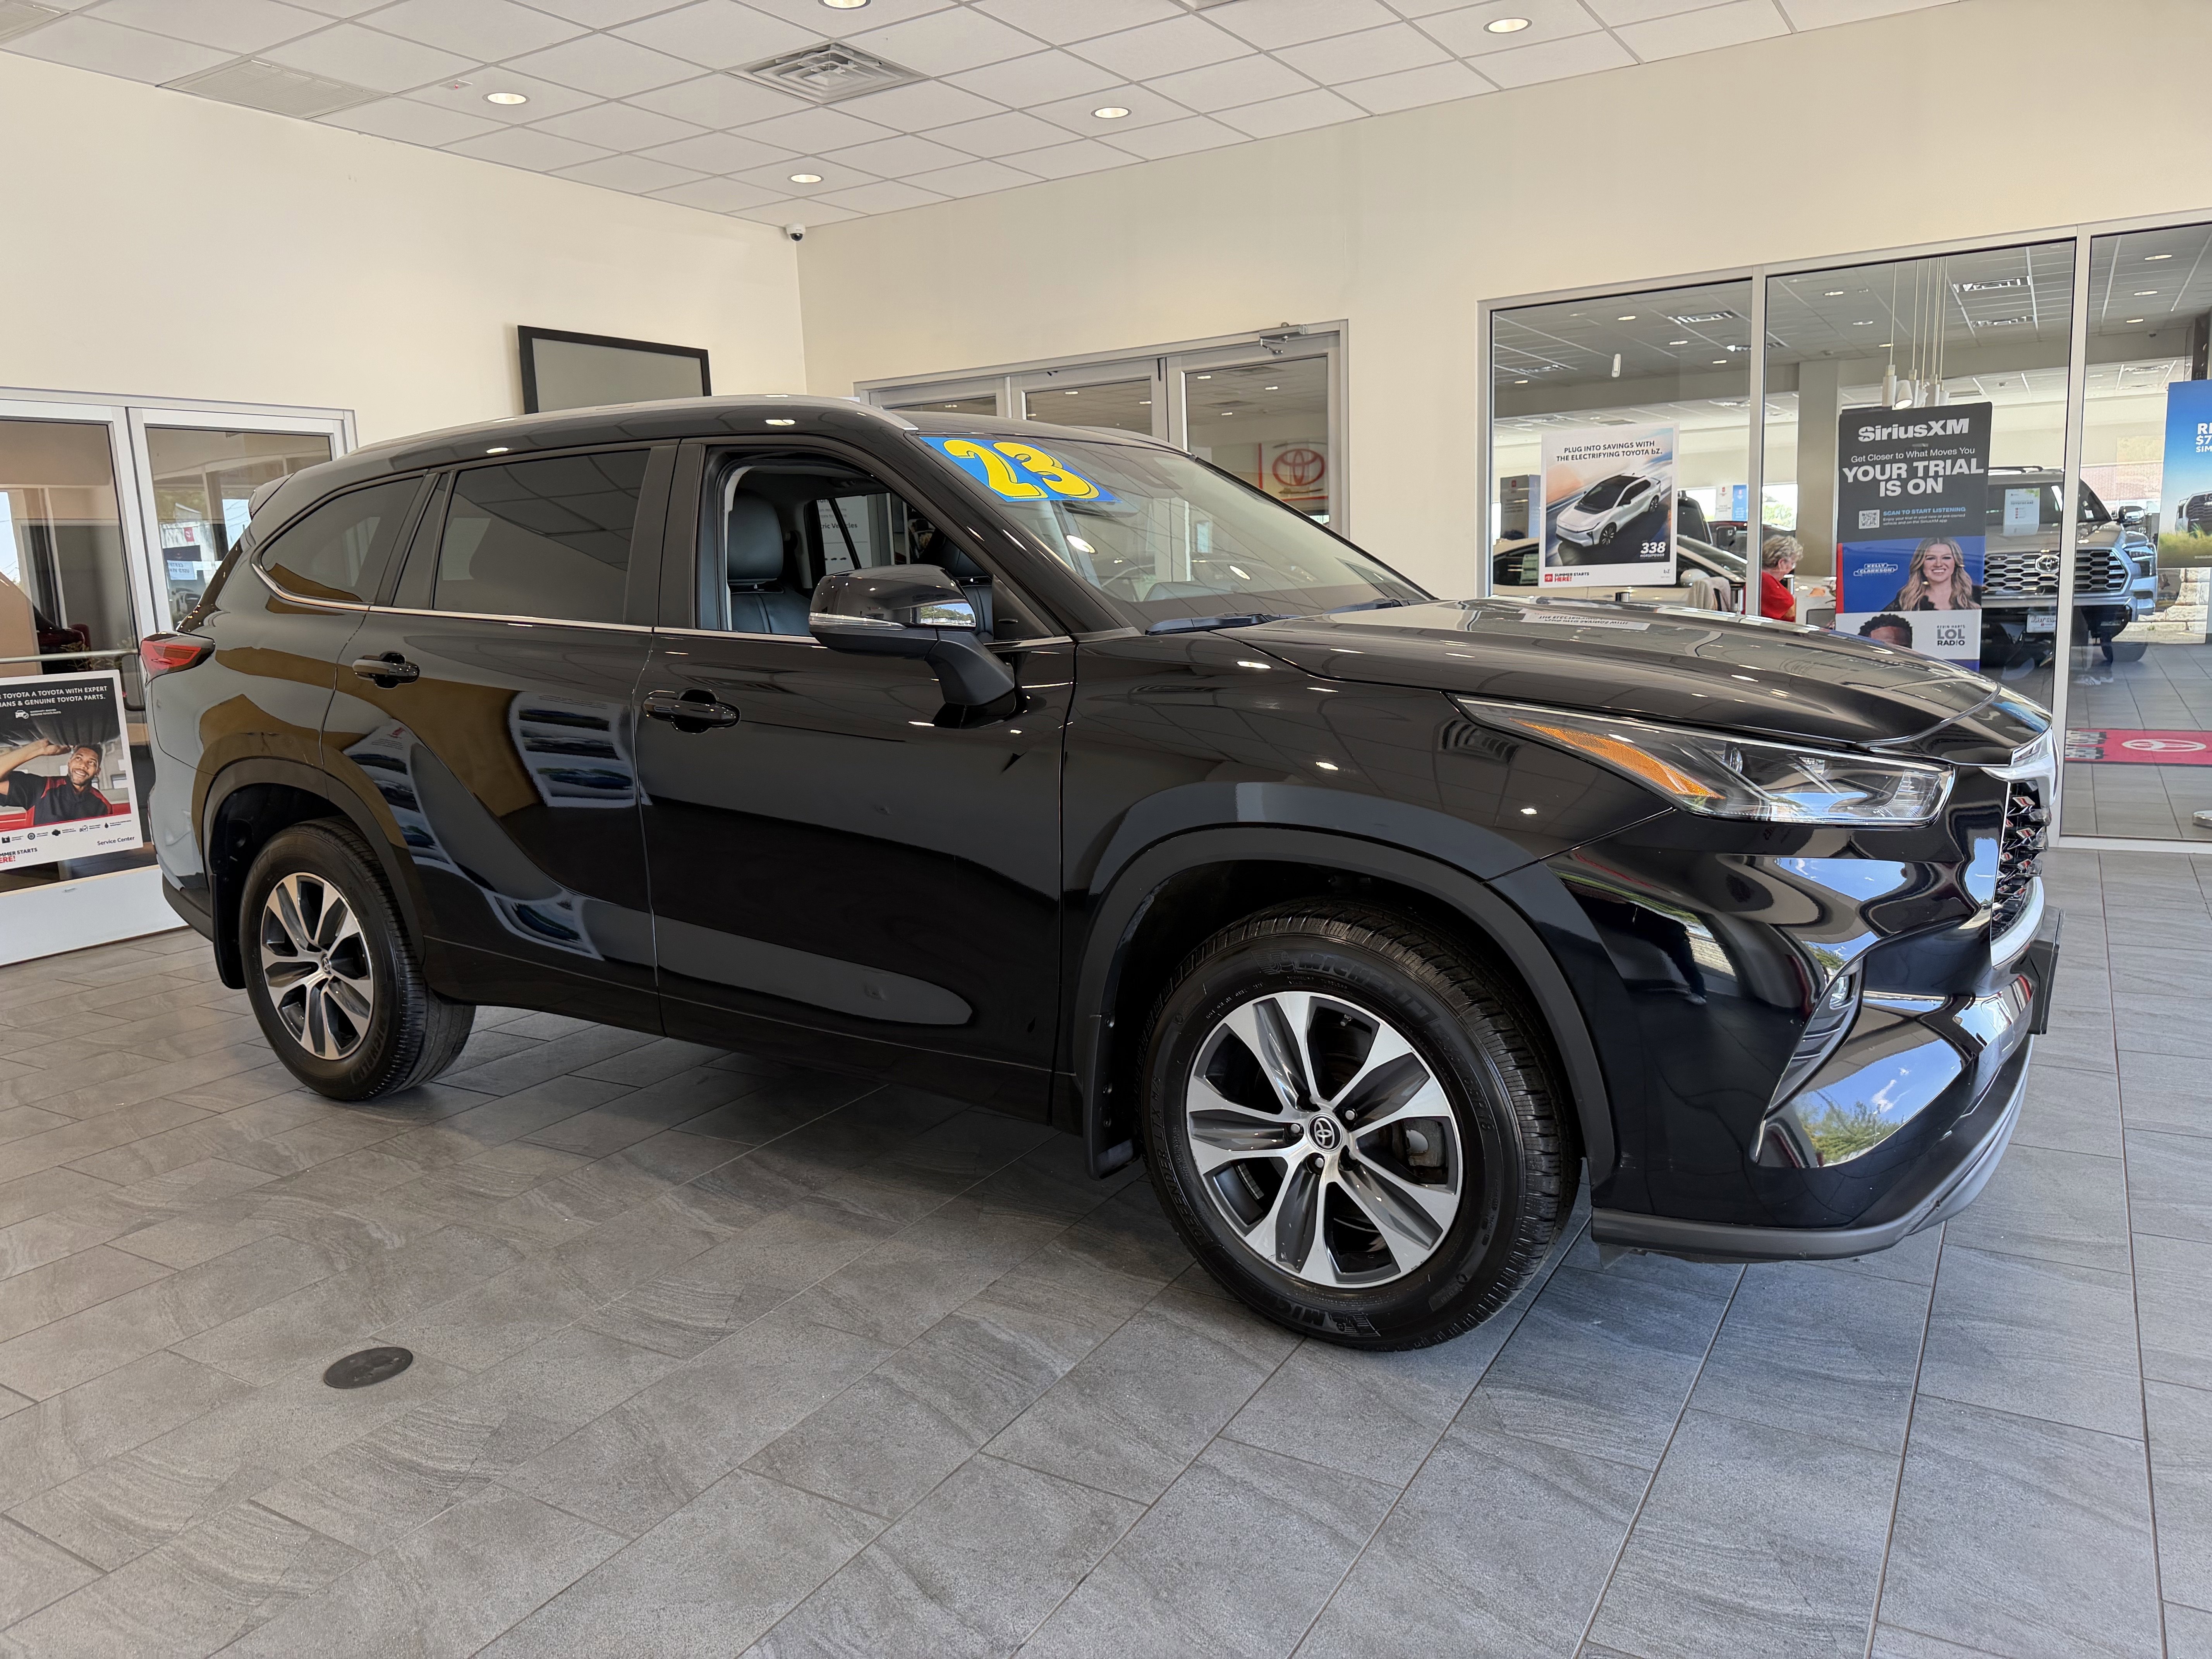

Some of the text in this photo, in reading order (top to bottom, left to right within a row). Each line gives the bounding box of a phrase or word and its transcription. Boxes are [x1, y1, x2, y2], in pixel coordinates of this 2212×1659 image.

[1858, 418, 1970, 442] SiriusXM
[1571, 451, 1619, 460] ELECTRIFYING
[1867, 453, 1893, 462] Closer
[1906, 450, 1928, 458] What
[1930, 448, 1957, 457] Moves
[944, 439, 1100, 499] 23
[1842, 458, 1984, 483] YOUR TRIAL
[1879, 477, 1943, 497] IS ON
[1640, 541, 1666, 554] 338
[1937, 629, 1965, 639] LOL
[1299, 953, 1430, 1019] MICHELIN
[1156, 1149, 1207, 1238] DEFENDER
